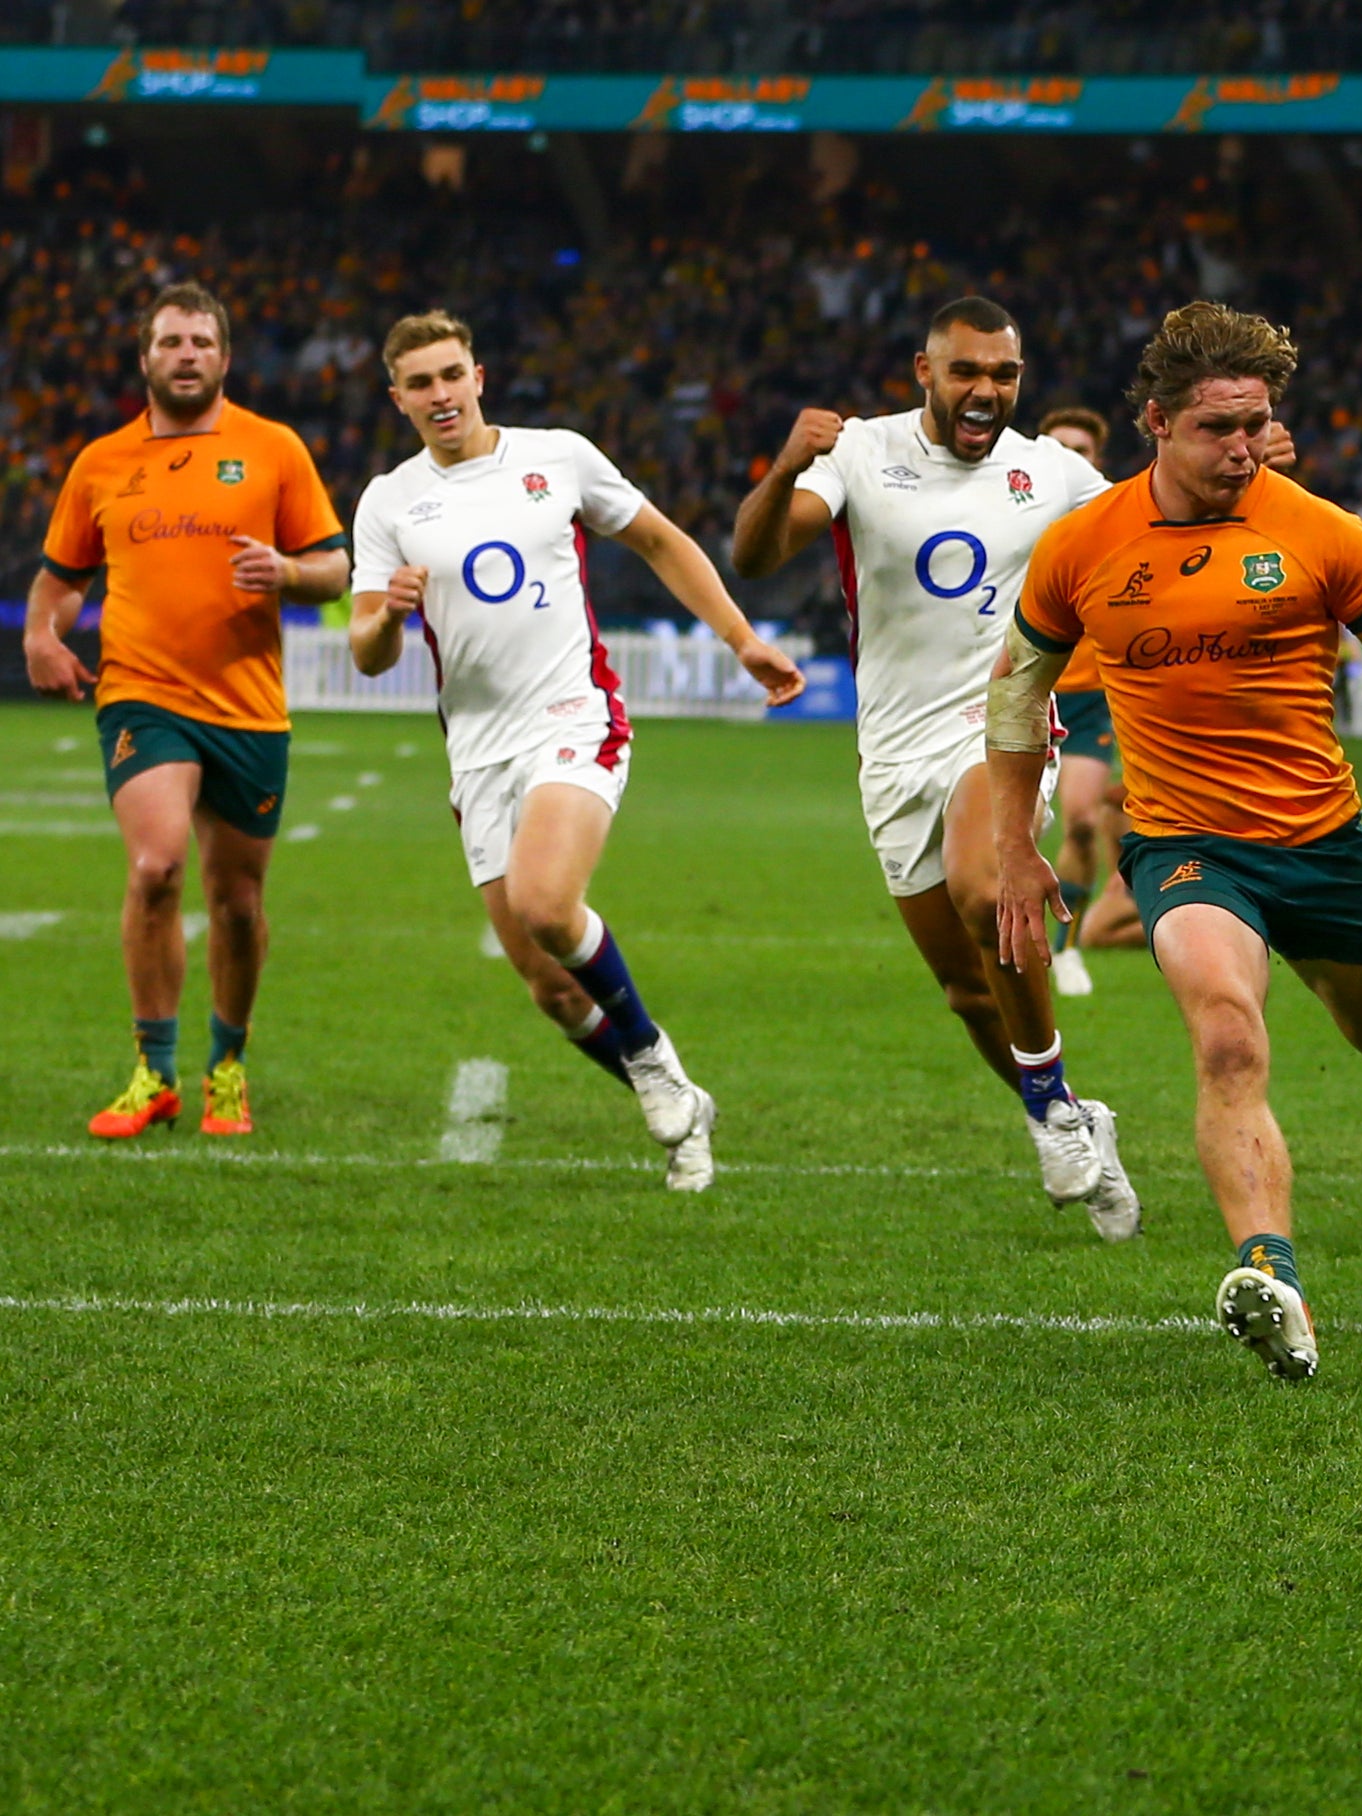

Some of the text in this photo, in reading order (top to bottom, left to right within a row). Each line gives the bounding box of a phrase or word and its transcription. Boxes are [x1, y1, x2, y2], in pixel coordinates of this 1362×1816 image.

[883, 481, 918, 491] umbro
[462, 540, 551, 610] O2
[915, 530, 997, 616] O2
[1126, 627, 1280, 670] Cadbury
